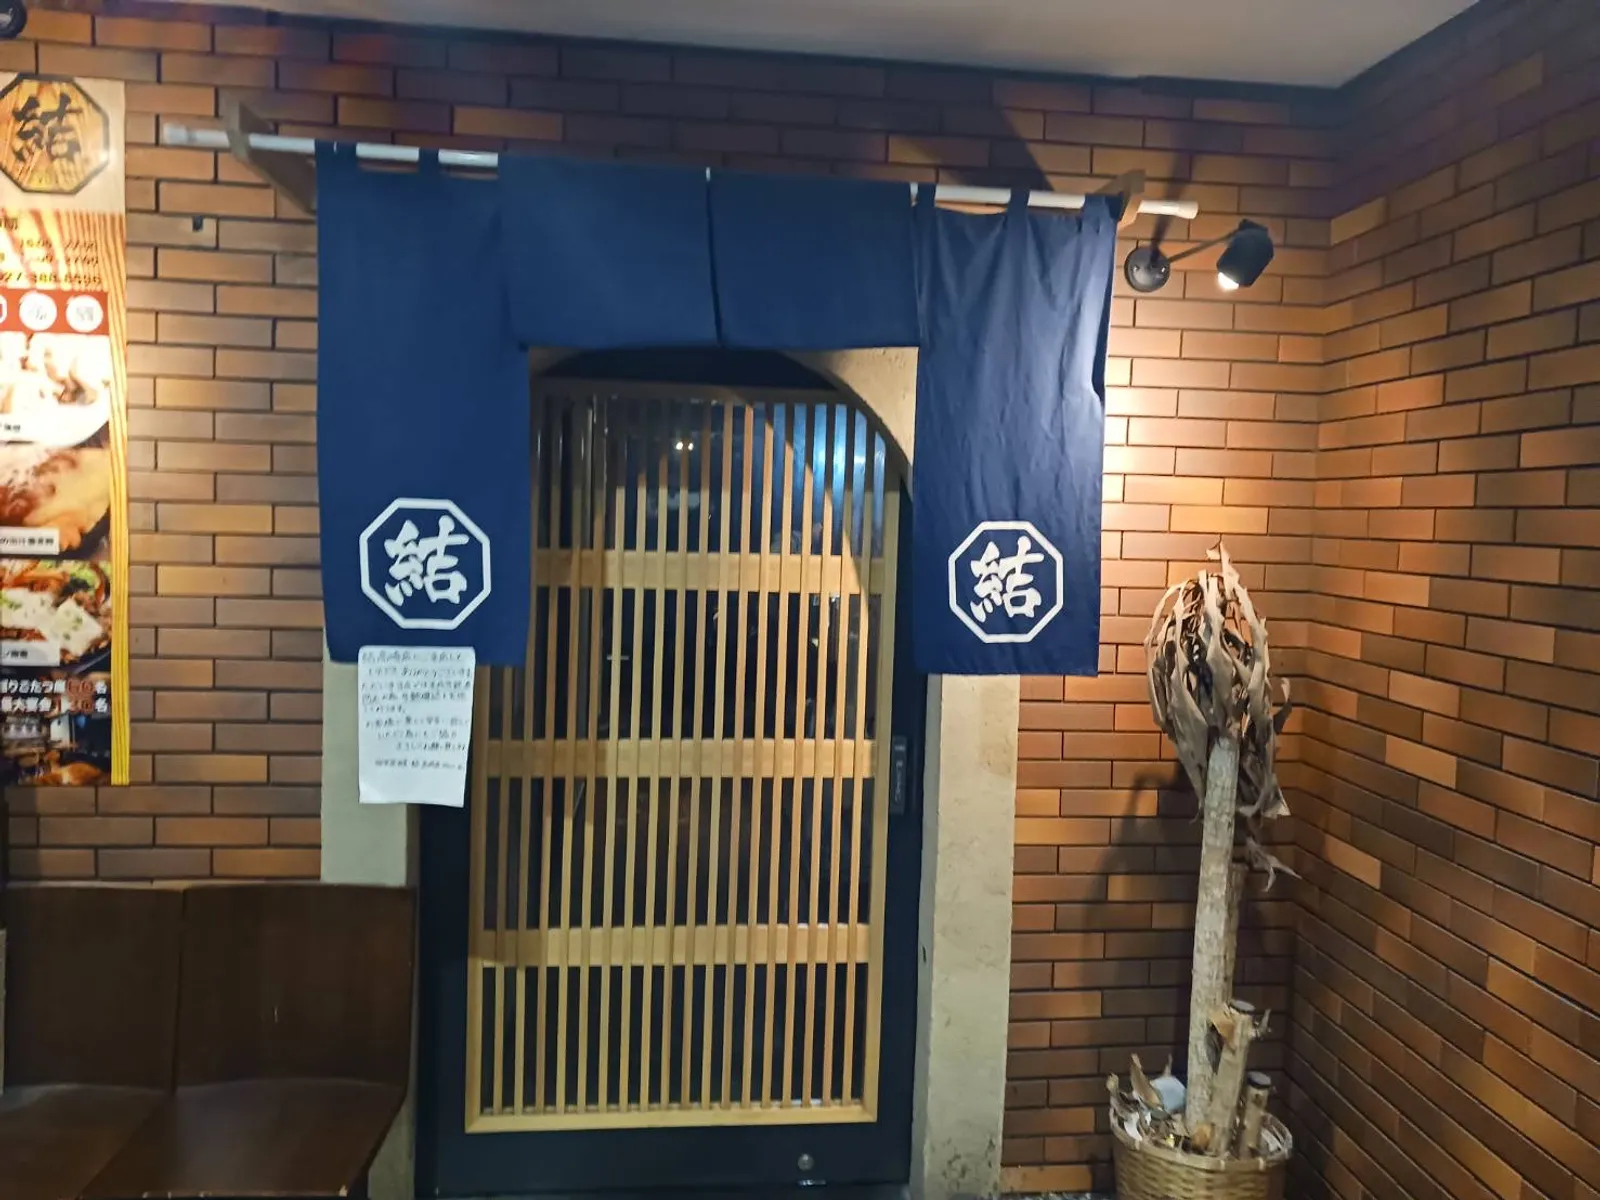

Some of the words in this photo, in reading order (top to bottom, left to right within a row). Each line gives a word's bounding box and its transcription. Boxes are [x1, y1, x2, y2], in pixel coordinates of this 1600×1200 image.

[12, 92, 83, 162] 結
[384, 515, 470, 606] 結
[970, 536, 1045, 622] 結
